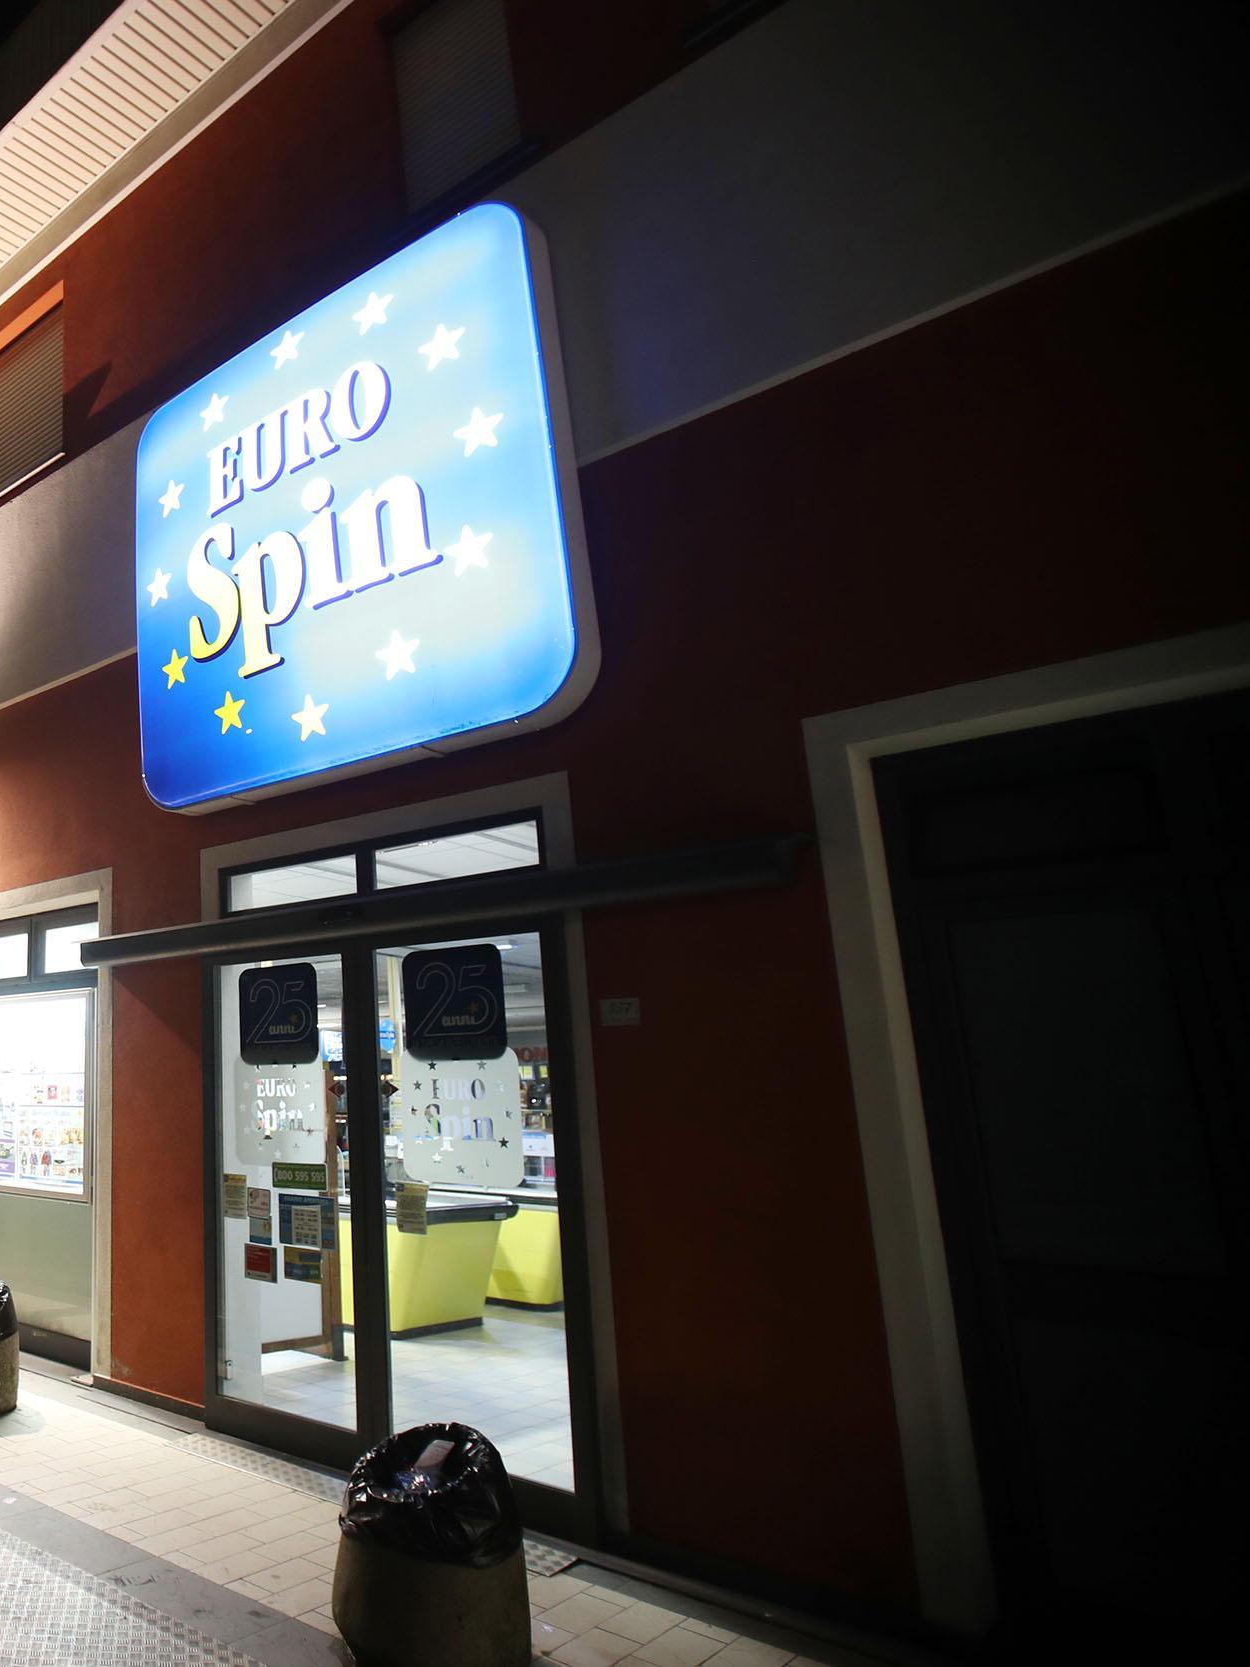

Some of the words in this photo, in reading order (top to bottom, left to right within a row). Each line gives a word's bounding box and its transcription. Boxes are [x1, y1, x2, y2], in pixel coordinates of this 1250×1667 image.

[206, 361, 391, 518] EURO
[186, 475, 443, 679] Spin
[247, 979, 312, 1044] 25
[413, 962, 497, 1037] 25
[256, 1078, 296, 1097] EURO
[432, 1079, 486, 1100] EURO
[423, 1103, 496, 1151] Spin
